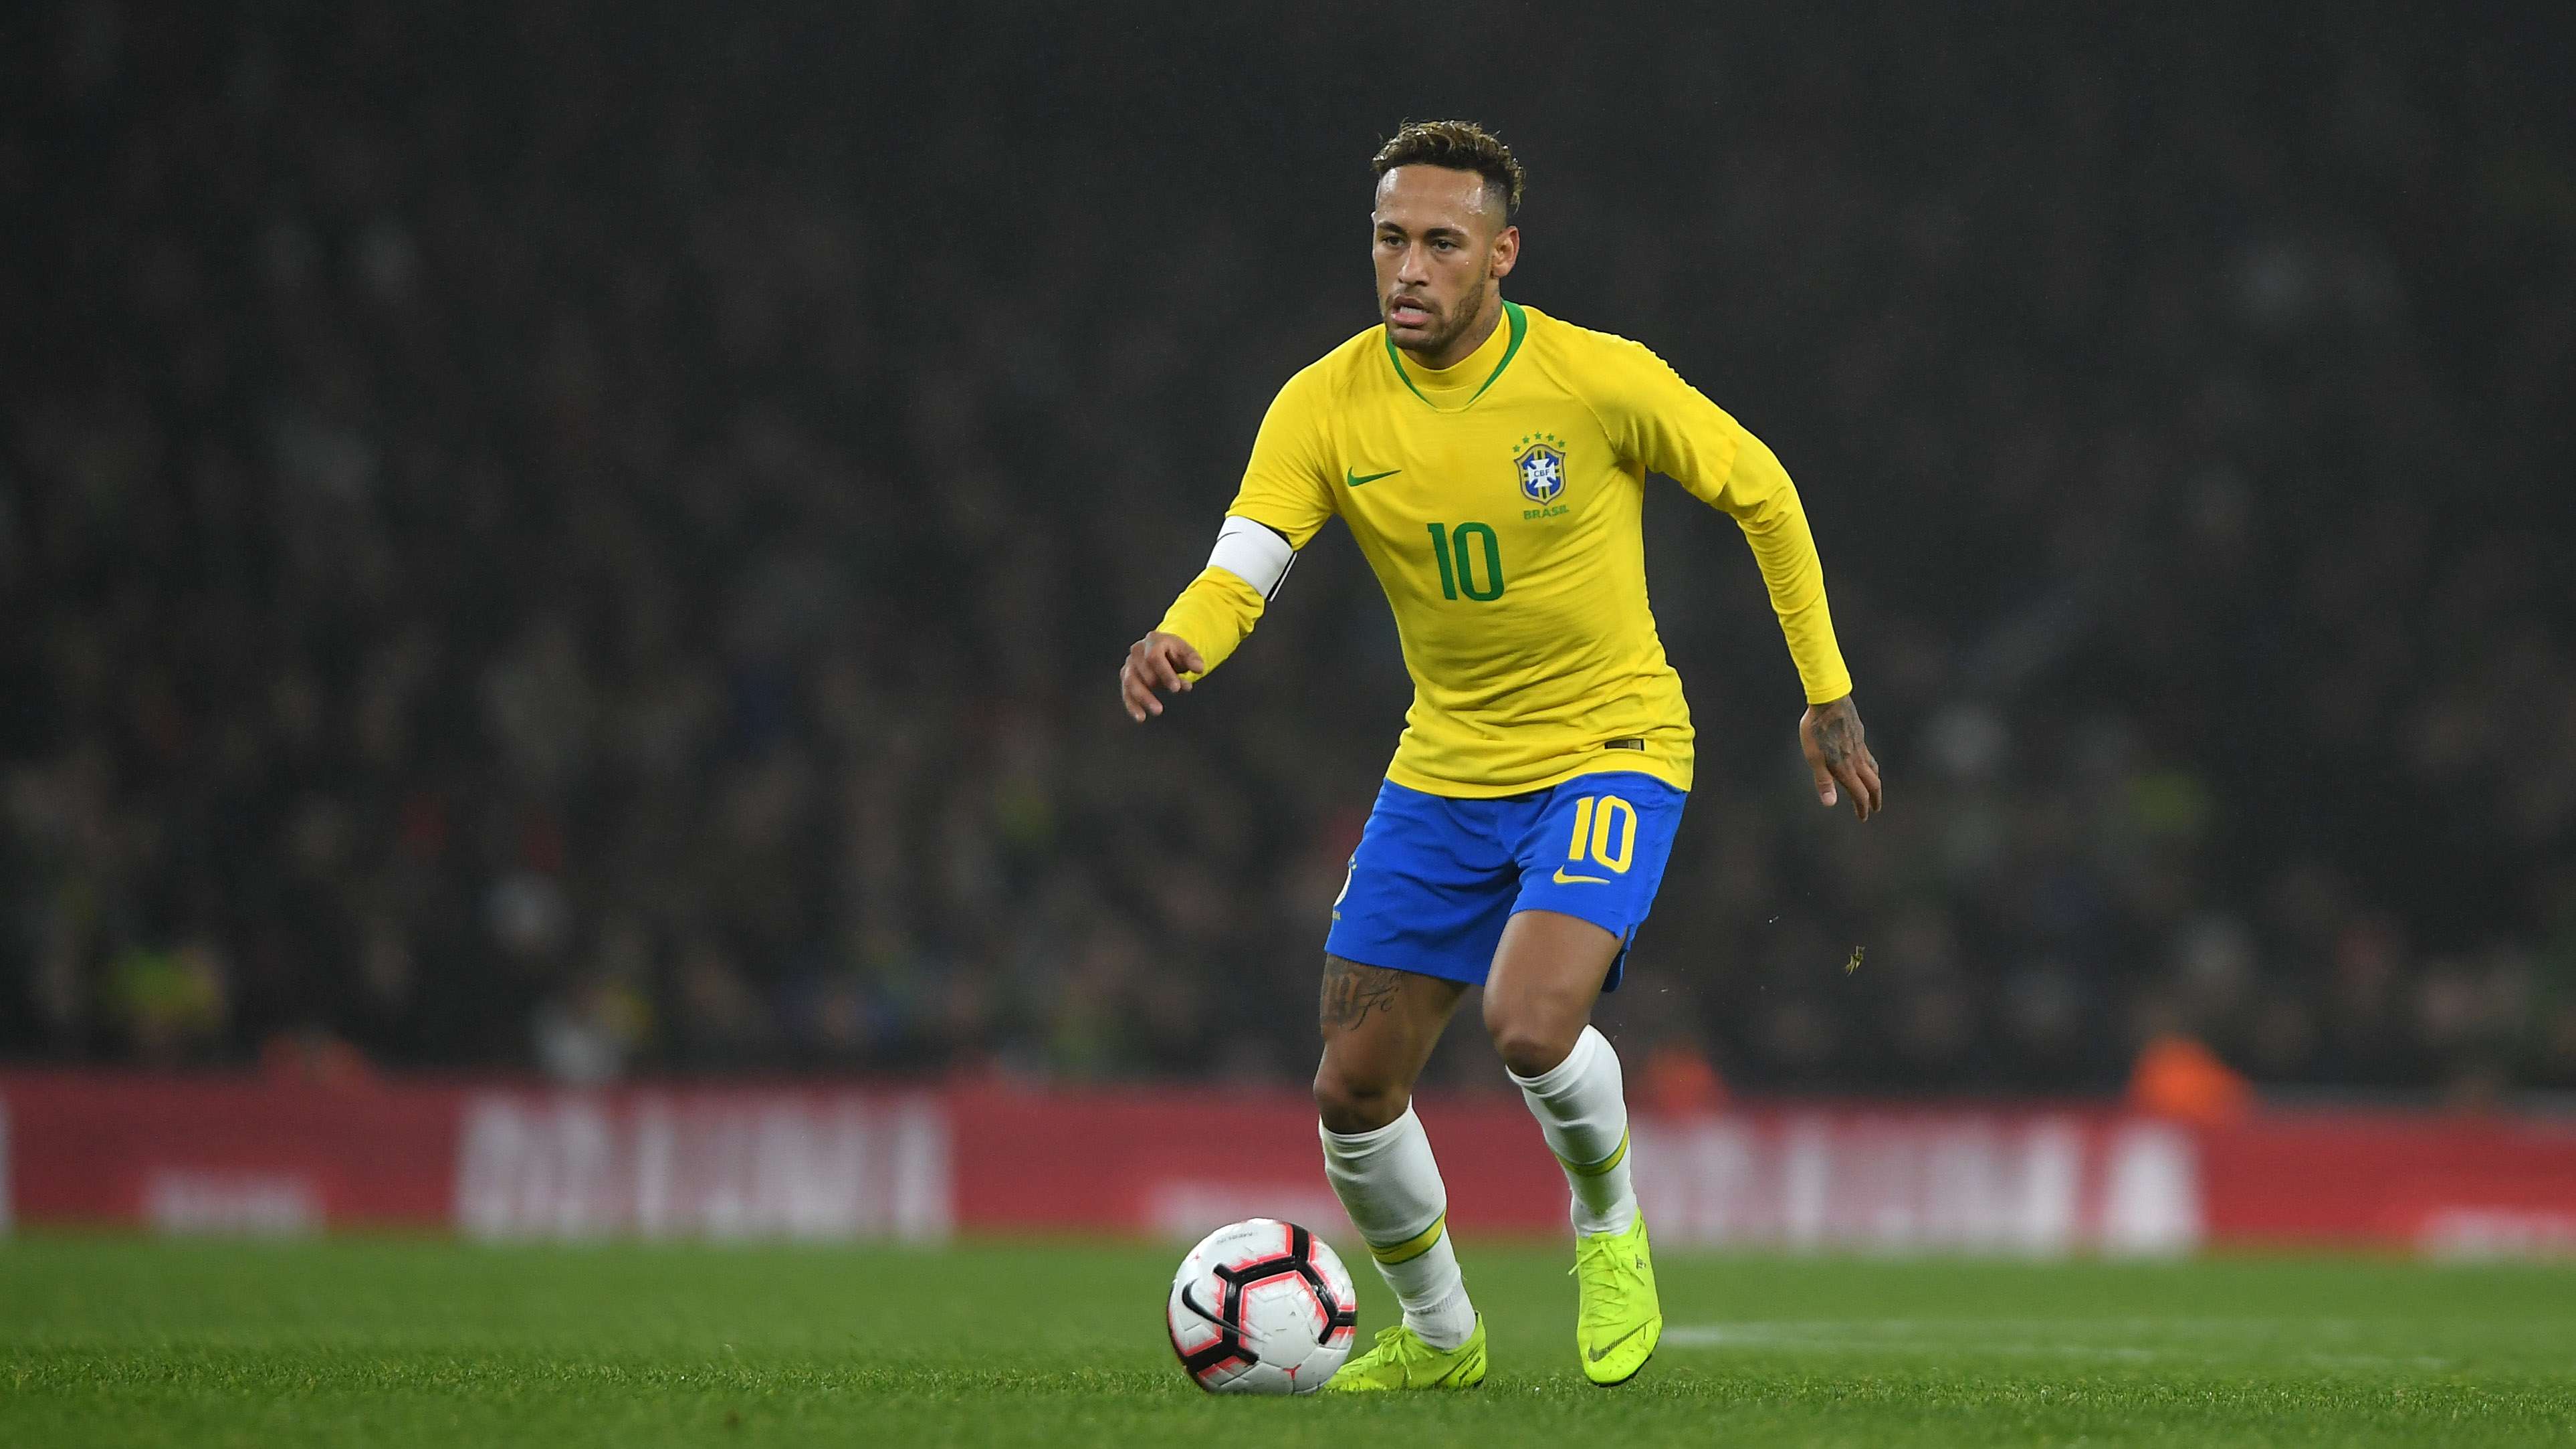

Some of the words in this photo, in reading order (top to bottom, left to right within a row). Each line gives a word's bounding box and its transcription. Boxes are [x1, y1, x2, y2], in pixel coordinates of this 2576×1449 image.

[1533, 469, 1550, 477] CBF
[1523, 505, 1570, 520] BRASIL
[1426, 522, 1505, 602] 10
[1568, 794, 1637, 873] 10
